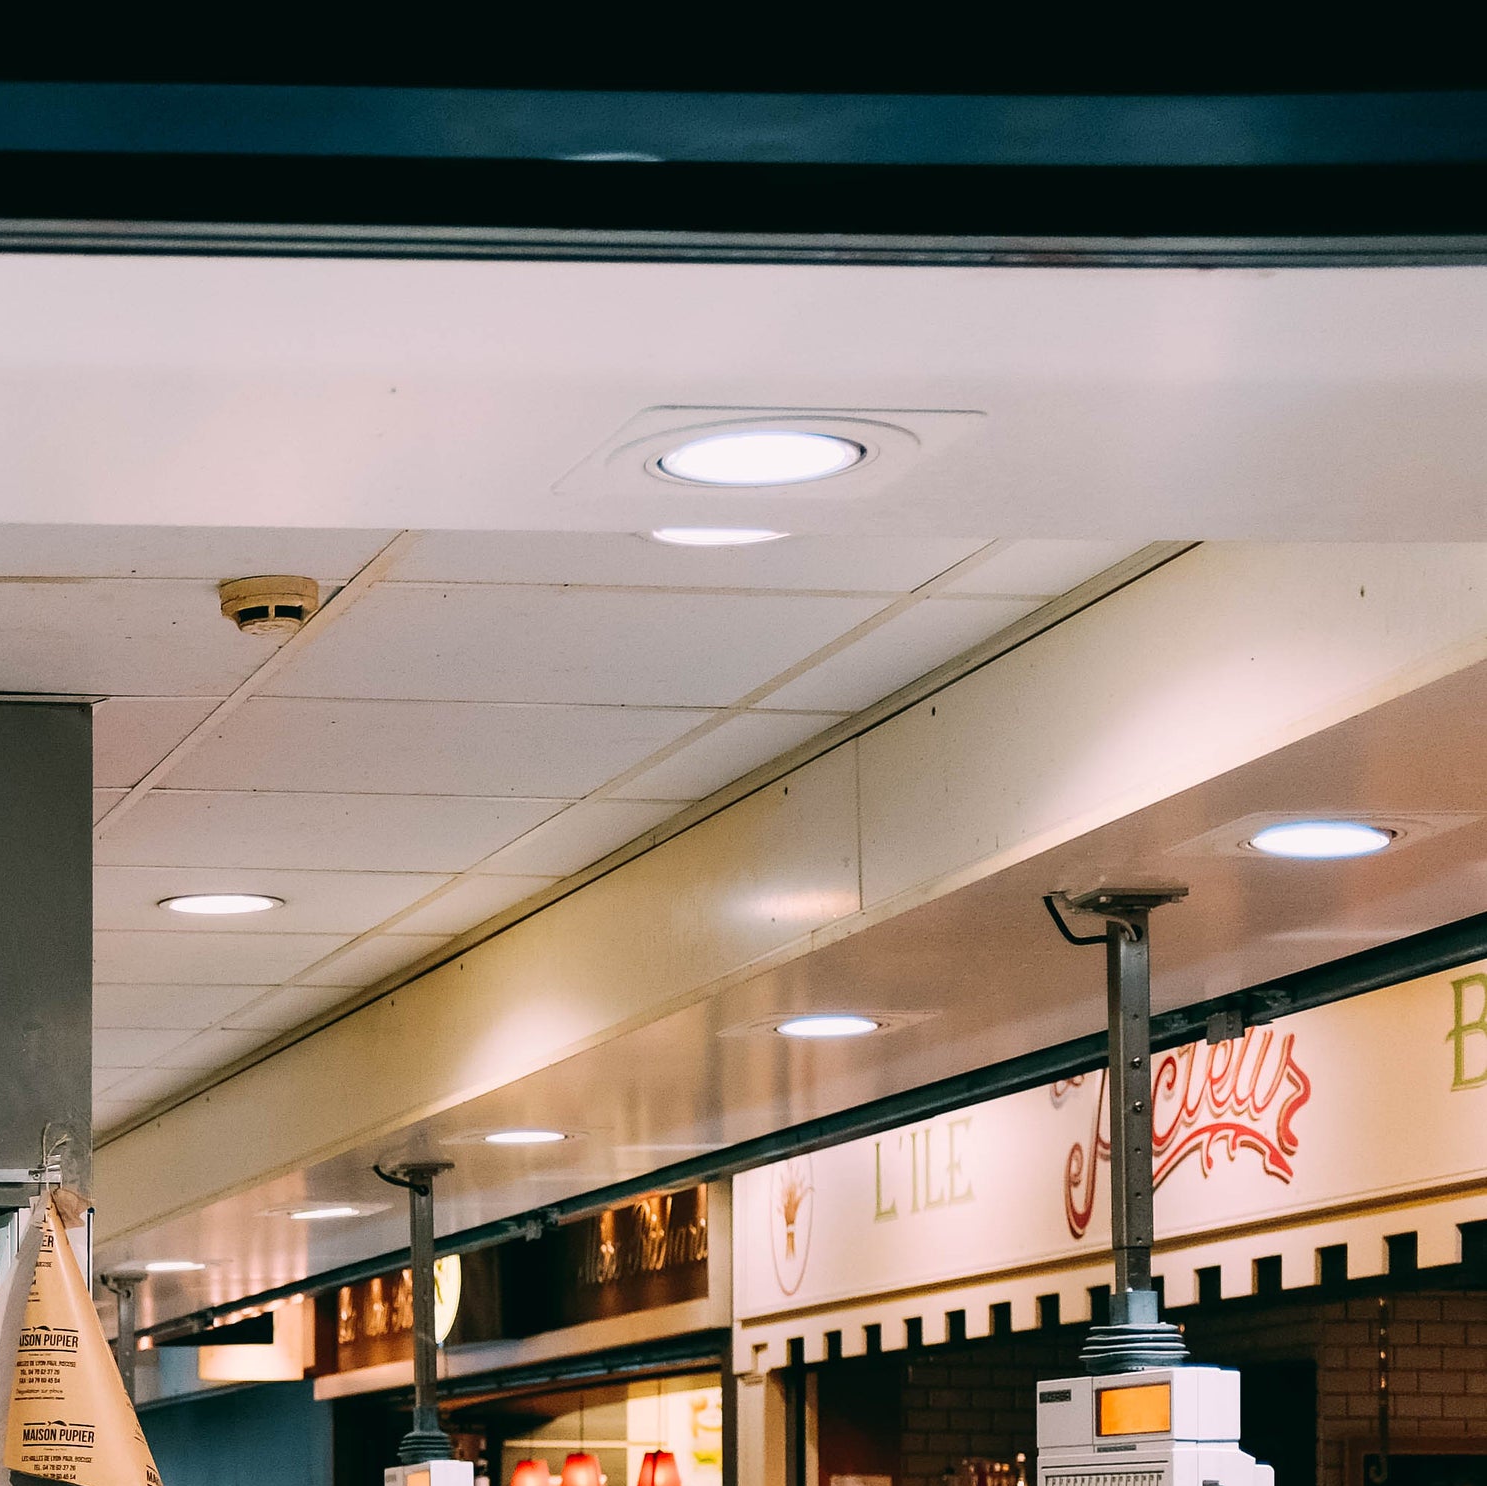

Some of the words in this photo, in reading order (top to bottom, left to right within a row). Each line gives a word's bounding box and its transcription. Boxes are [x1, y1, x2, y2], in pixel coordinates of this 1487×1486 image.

[43, 1333, 79, 1348] PUPIER
[22, 1428, 57, 1442] MAISON
[59, 1429, 95, 1443] PUPIER
